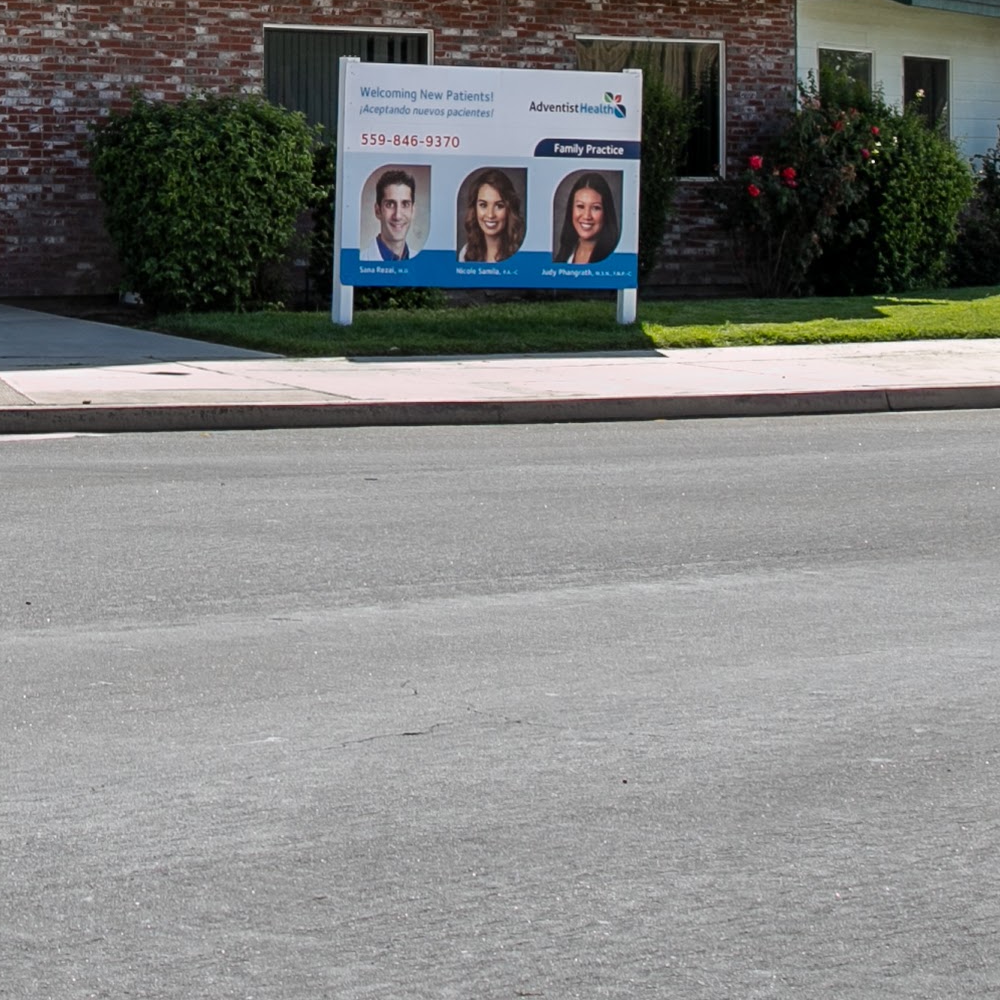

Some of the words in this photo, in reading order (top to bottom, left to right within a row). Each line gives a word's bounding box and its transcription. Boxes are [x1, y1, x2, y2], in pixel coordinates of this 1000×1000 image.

[360, 86, 417, 103] Welcoming
[419, 89, 444, 100] New
[446, 89, 494, 102] Patients!
[359, 104, 411, 116] ¡Aceptando
[412, 108, 445, 116] nuevos
[446, 107, 494, 118] pacientes!
[360, 133, 461, 148] 559-846-9370
[553, 142, 584, 157] Family
[585, 144, 625, 156] Practice
